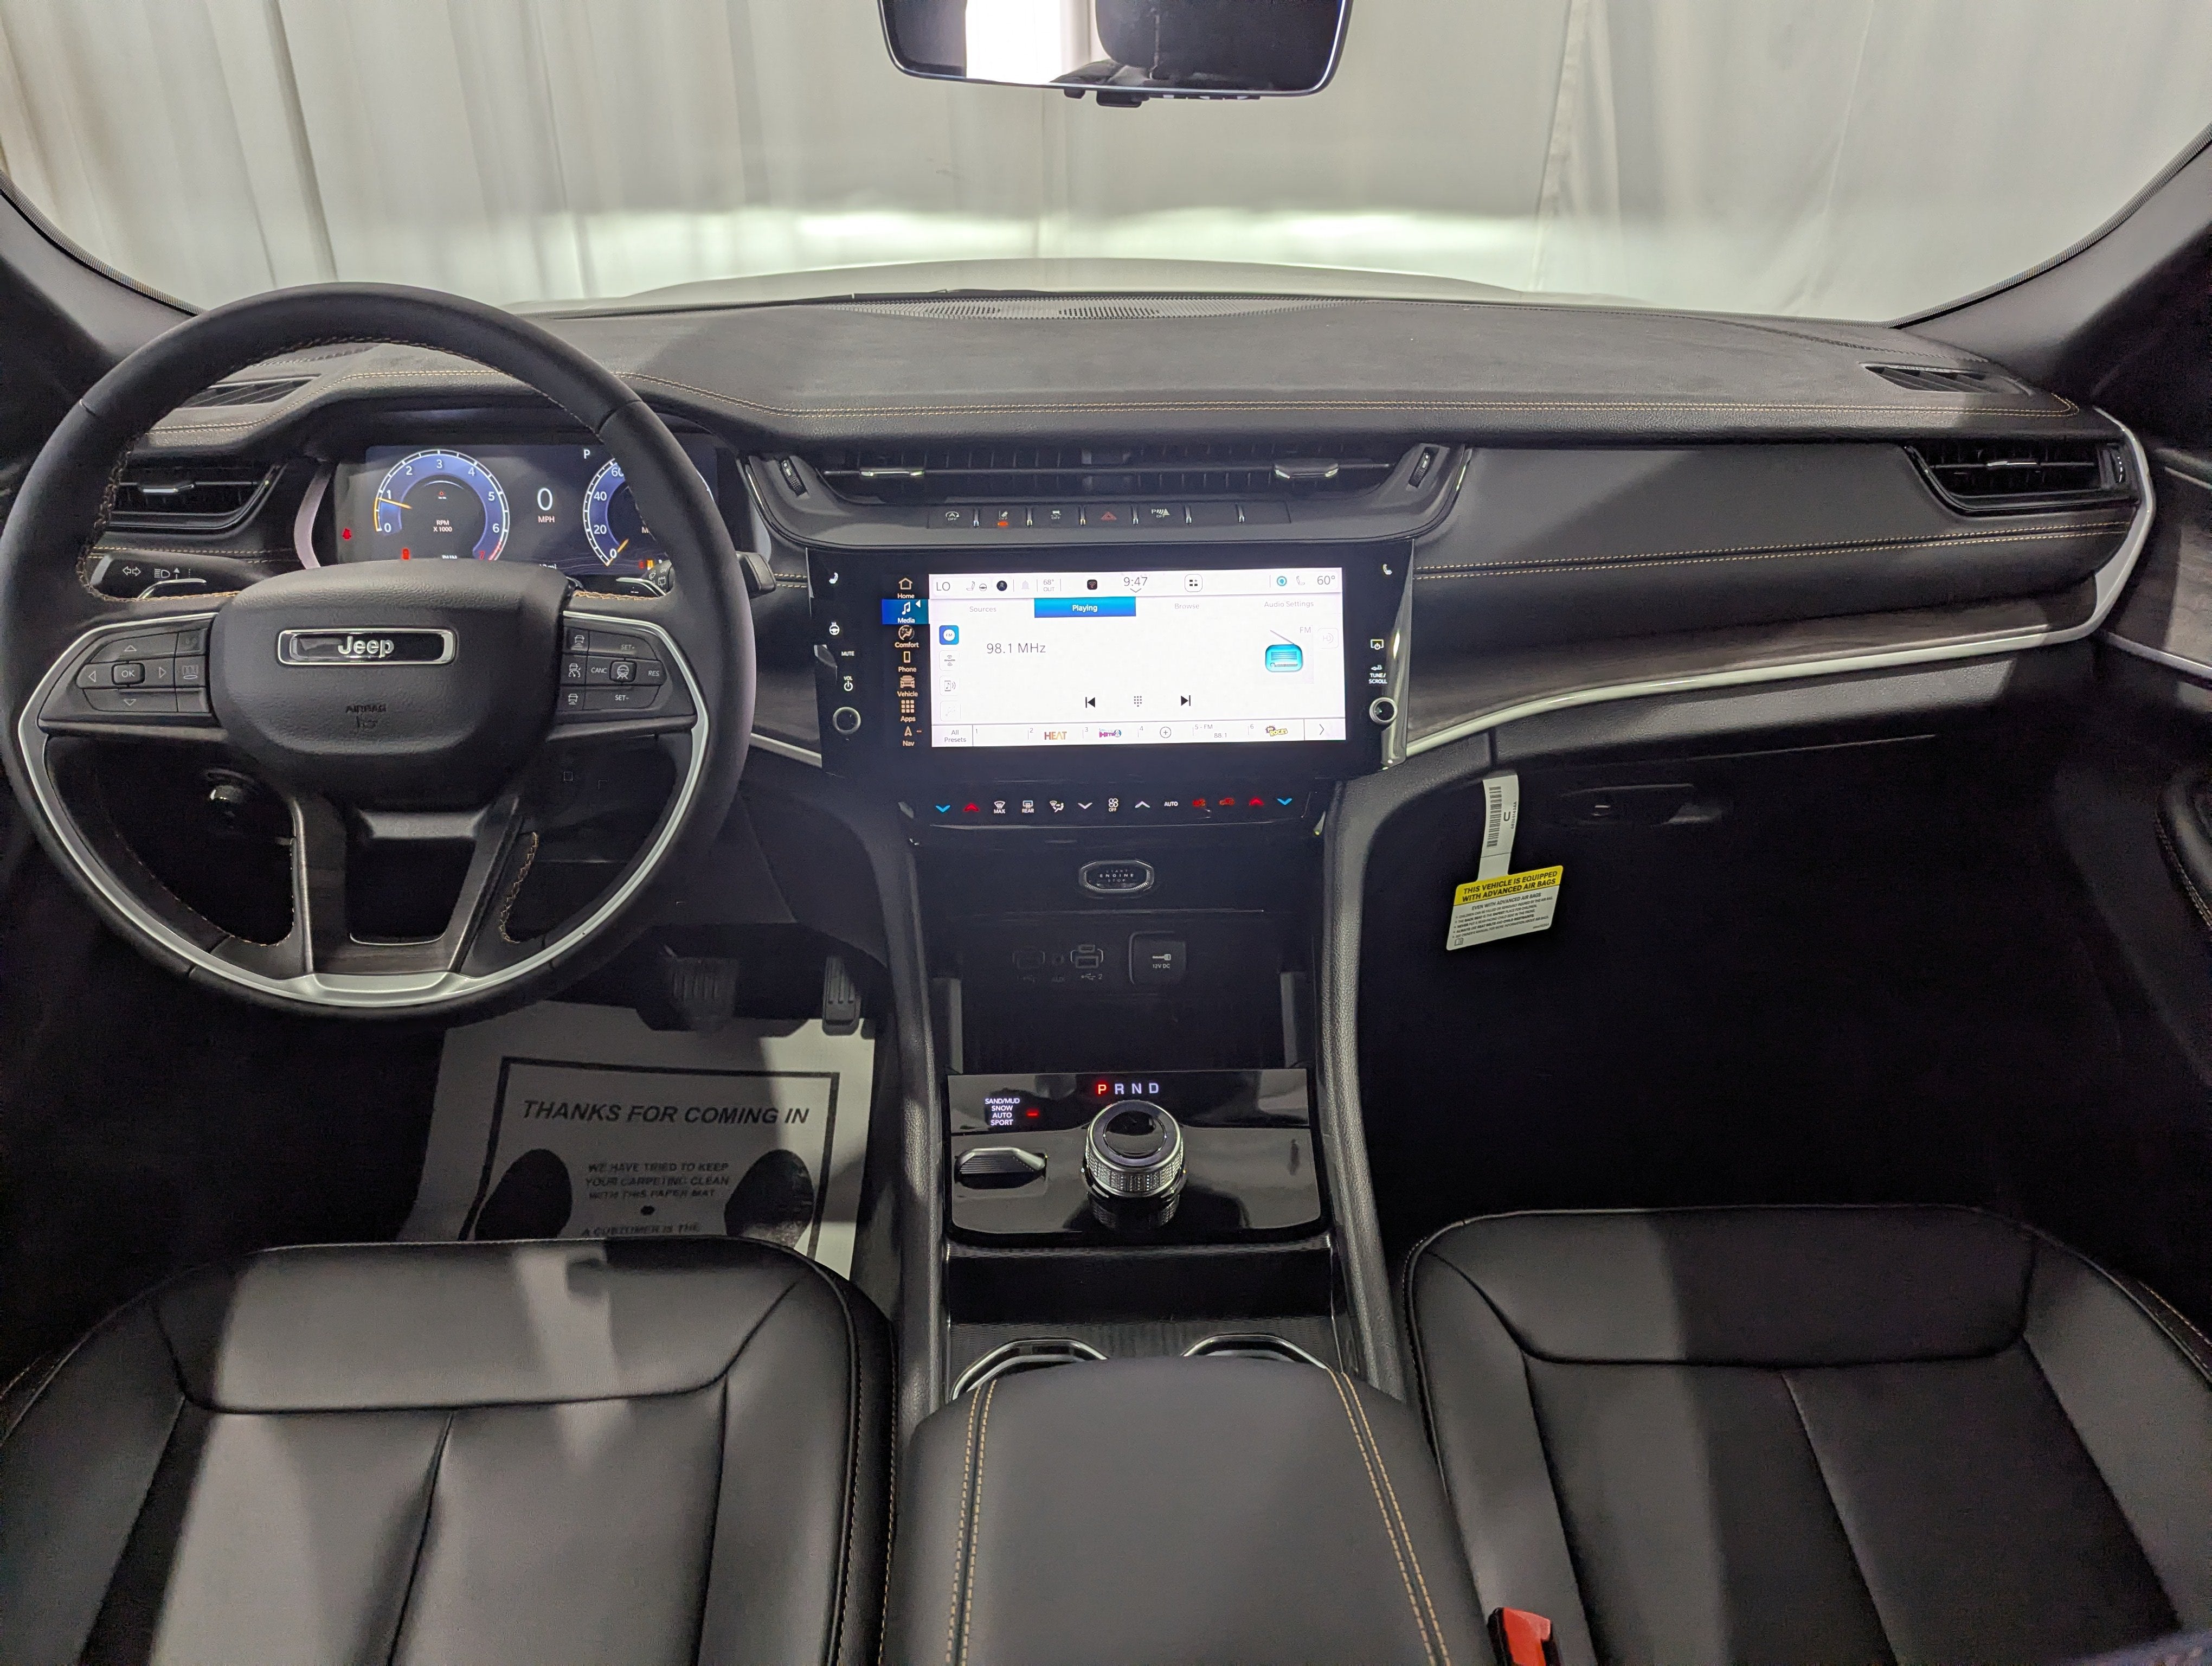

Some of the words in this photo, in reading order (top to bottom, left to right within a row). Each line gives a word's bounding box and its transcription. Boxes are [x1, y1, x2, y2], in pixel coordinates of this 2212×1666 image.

[583, 450, 590, 459] P
[436, 460, 442, 469] 3
[406, 466, 413, 476] 2
[468, 467, 475, 476] 4
[386, 490, 391, 499] 1
[488, 492, 494, 501] 5
[537, 488, 553, 511] 0
[594, 491, 607, 501] 40
[384, 523, 391, 533] 0
[492, 524, 499, 533] 6
[594, 525, 607, 534] 20
[479, 551, 485, 560] 7
[610, 549, 617, 559] 0
[1124, 577, 1147, 586] 9:47
[1317, 575, 1335, 585] 60°
[936, 582, 950, 591] LO
[338, 636, 394, 658] Jeep
[987, 643, 1012, 654] 98.1
[1018, 643, 1046, 653] MHz
[1044, 731, 1067, 740] HEAT
[1503, 811, 1511, 822] U
[1464, 886, 1480, 894] THIS
[1482, 879, 1512, 890] VEHICLE
[1522, 871, 1557, 883] EQUIPPED
[1463, 893, 1481, 902] WITH
[1483, 885, 1522, 898] ADVANCED
[1537, 879, 1555, 887] BAGS
[1496, 897, 1521, 905] ADVANCED
[1098, 1084, 1107, 1094] P
[1115, 1084, 1124, 1094] R
[1132, 1083, 1142, 1093] N
[1149, 1083, 1159, 1093] D
[523, 1100, 621, 1122] THANKS
[626, 1105, 678, 1123] FOR
[684, 1106, 779, 1124] COMING
[784, 1108, 809, 1124] IN
[611, 1163, 639, 1172] HAVE
[682, 1163, 695, 1171] TO
[698, 1163, 729, 1171] KEEP
[690, 1176, 730, 1186] CLEAN
